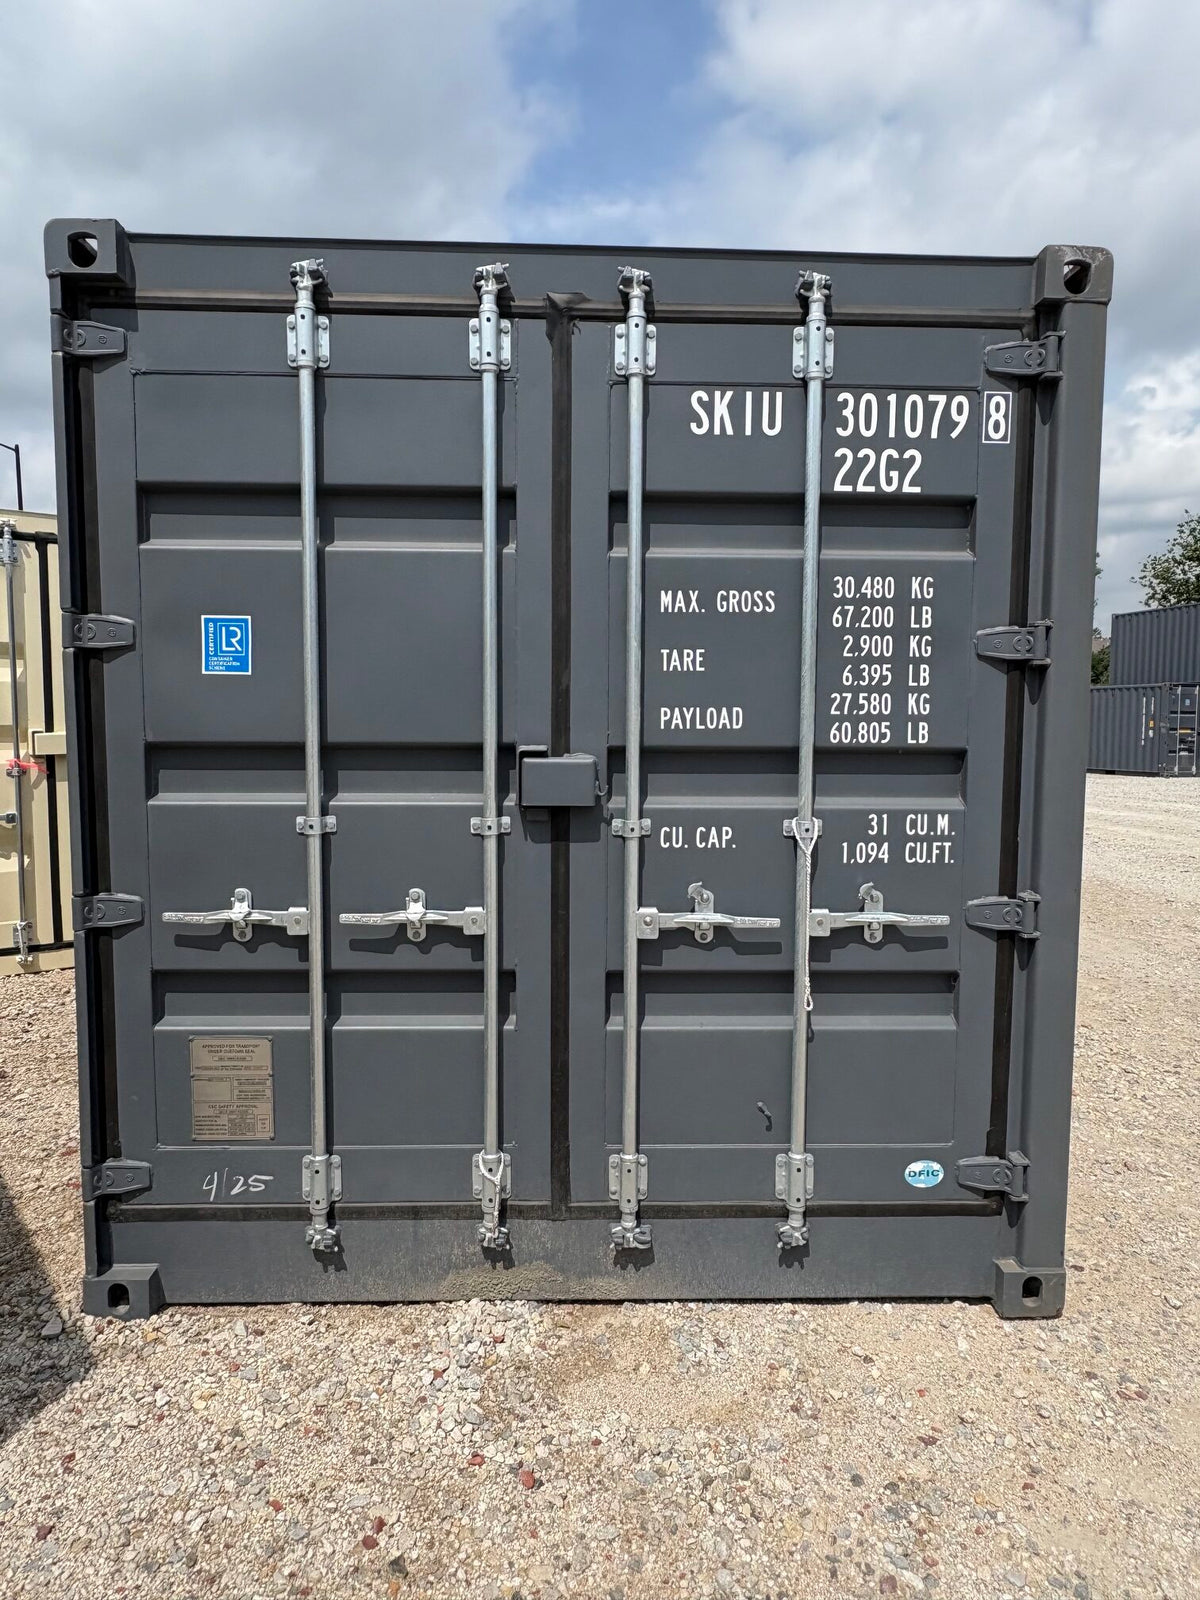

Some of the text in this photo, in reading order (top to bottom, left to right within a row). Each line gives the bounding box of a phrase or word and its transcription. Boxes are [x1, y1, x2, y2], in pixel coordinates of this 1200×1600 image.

[690, 390, 1006, 439] SKIU 301079 8
[833, 447, 922, 493] 22G2
[832, 575, 934, 599] 30,480 KG
[660, 590, 776, 613] MAX. GROSS
[832, 605, 932, 629] 67,200 LB
[222, 626, 242, 651] LR
[842, 634, 932, 658] 2,900 KG
[660, 648, 705, 672] TARE
[842, 663, 930, 687] 6,395 LB
[830, 692, 931, 715] 27,580 KG
[660, 706, 743, 730] PAYLOAD
[829, 721, 929, 744] 60,805 LB
[867, 813, 956, 836] 31 CU.M.
[660, 826, 737, 849] CU. CAP.
[841, 841, 955, 864] 1,094 CU.FT.
[202, 1167, 274, 1202] 4/25
[908, 1169, 940, 1178] DFIC
